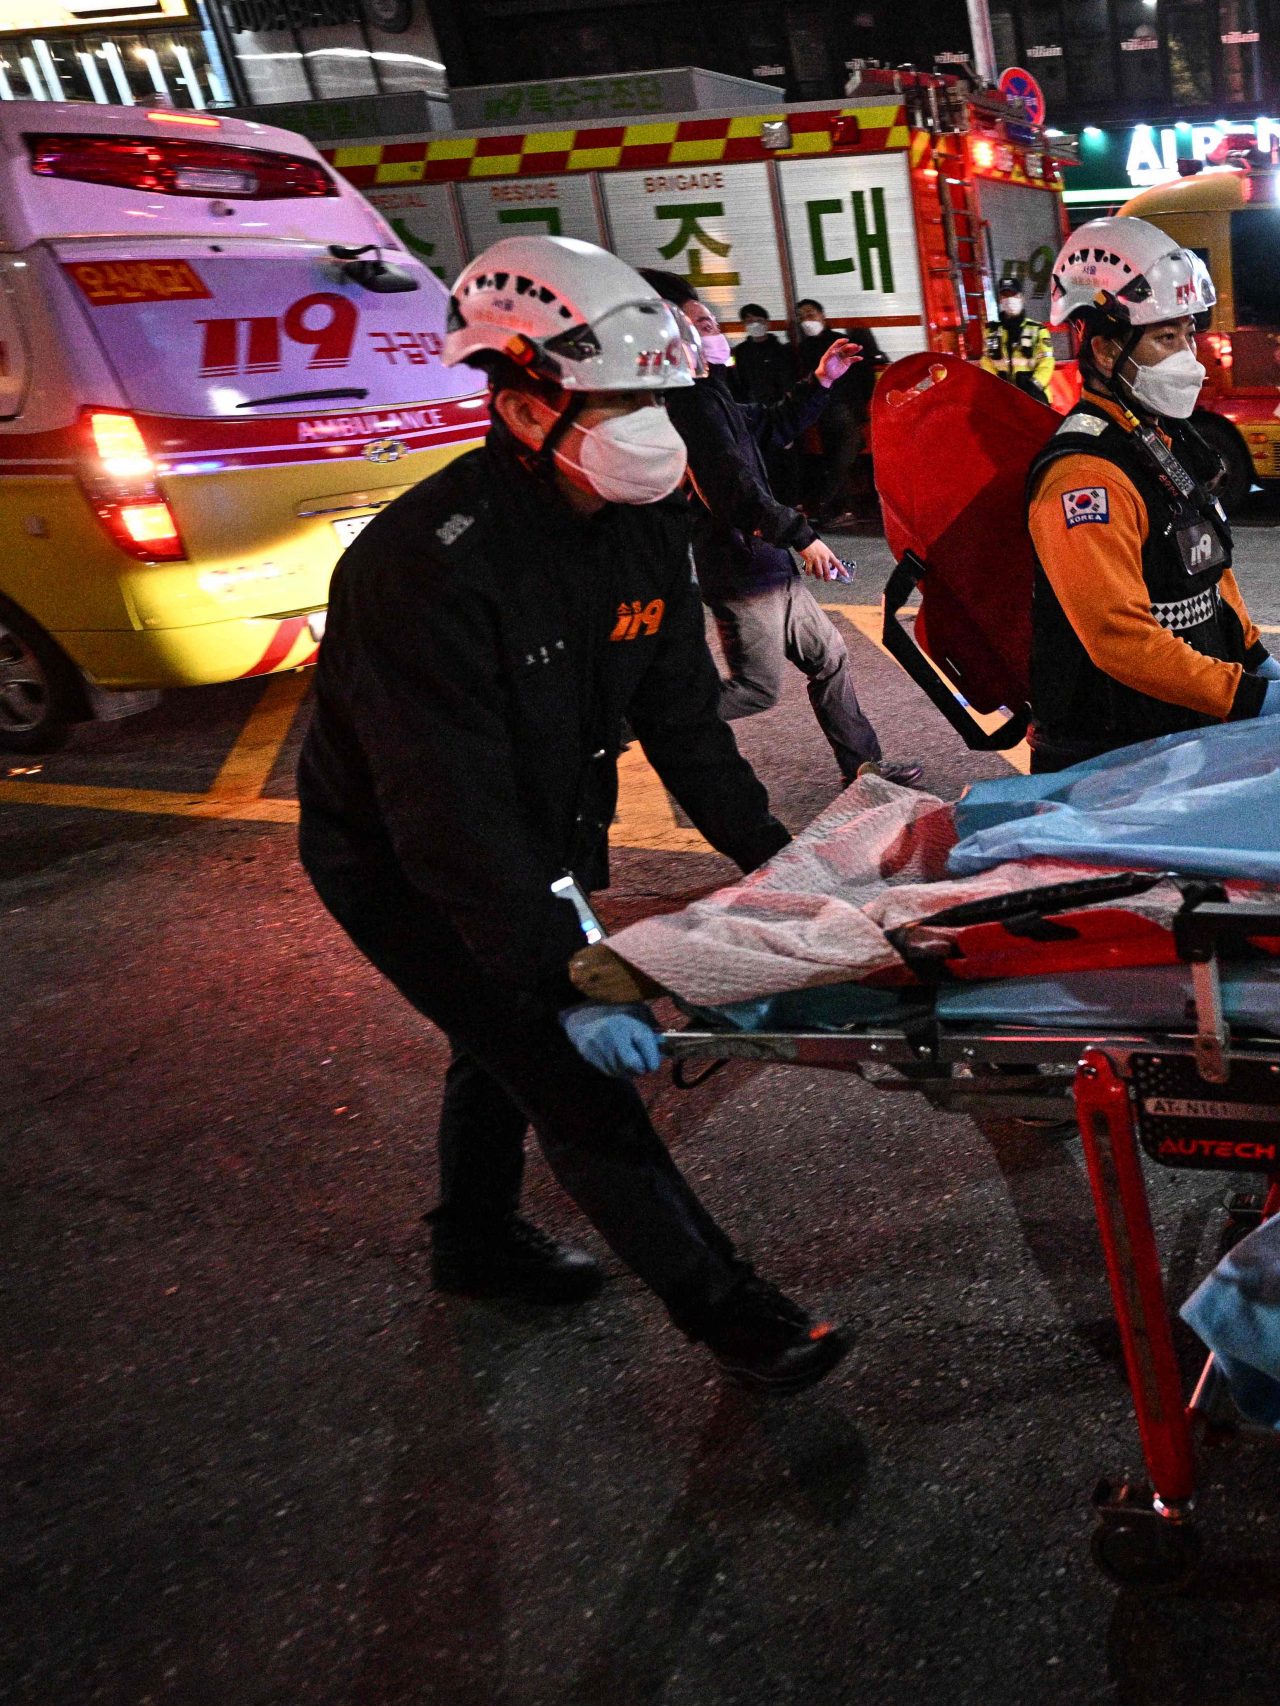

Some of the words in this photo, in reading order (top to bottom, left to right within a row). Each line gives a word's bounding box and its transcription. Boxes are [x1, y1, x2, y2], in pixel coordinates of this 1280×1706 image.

[491, 181, 559, 201] RESCUE
[644, 172, 725, 193] BRIGADE
[193, 292, 360, 379] 119
[297, 408, 446, 442] AMBULANCE
[1069, 513, 1103, 526] KOREA
[1190, 533, 1213, 567] 119
[608, 598, 666, 642] 119
[1158, 1137, 1277, 1162] AUTECH
